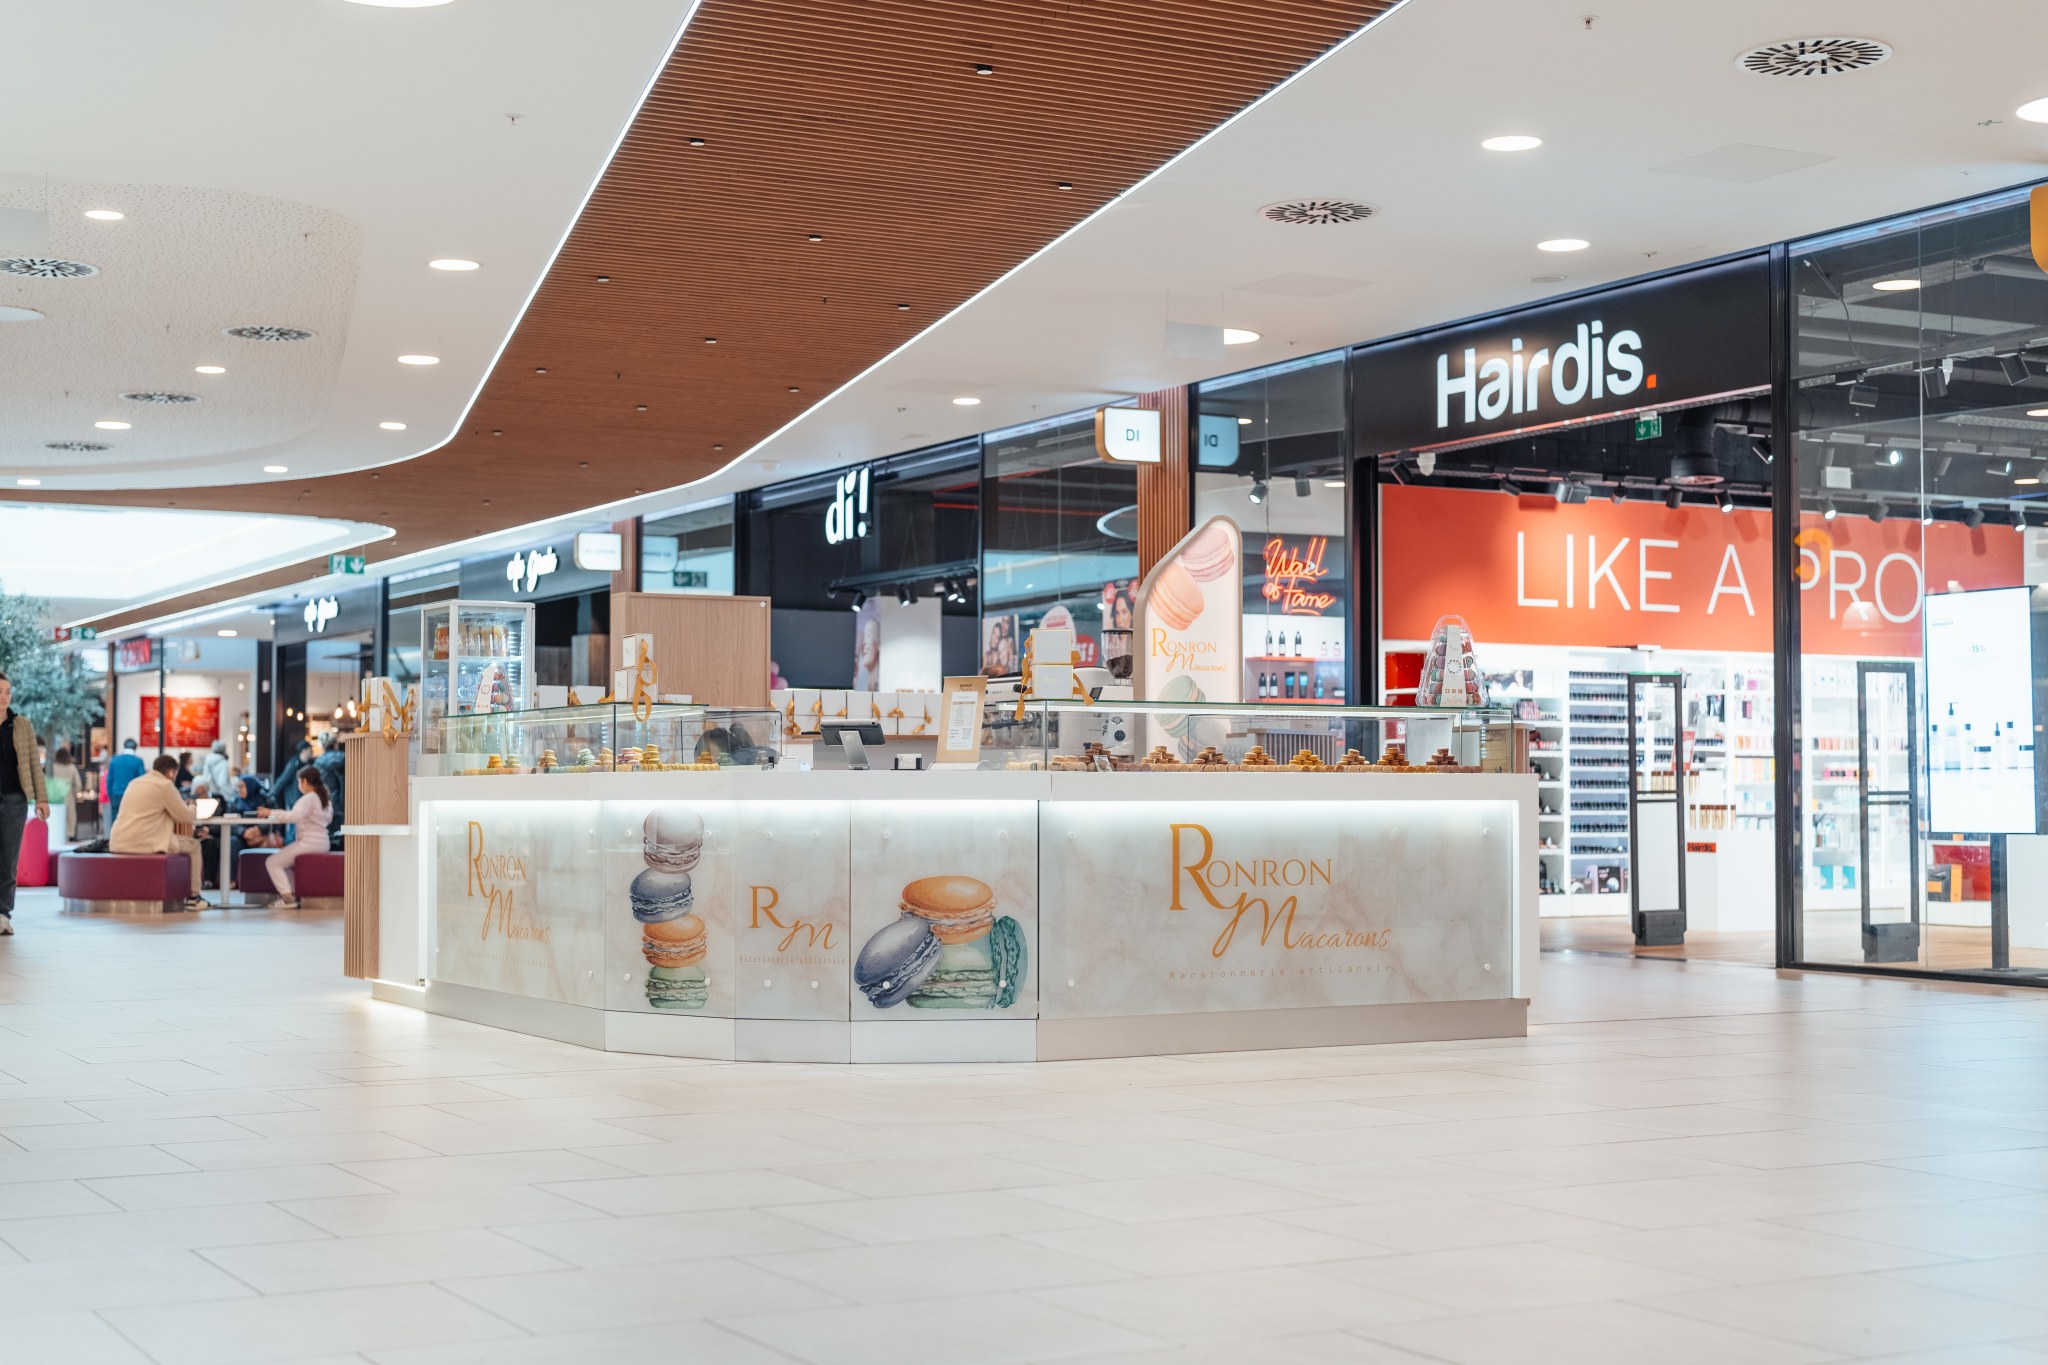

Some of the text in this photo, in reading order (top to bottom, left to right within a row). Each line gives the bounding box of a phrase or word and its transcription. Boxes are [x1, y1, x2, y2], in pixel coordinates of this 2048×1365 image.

[1437, 320, 1656, 428] Hairdis.
[1126, 429, 1139, 441] DI
[825, 466, 869, 544] di!
[1264, 537, 1328, 578] Wall
[1518, 531, 1680, 613] LIKE
[1706, 544, 1755, 616] A
[1263, 571, 1336, 613] of Fame
[1212, 892, 1391, 957] Macarons
[1169, 967, 1286, 979] Macaronnerie
